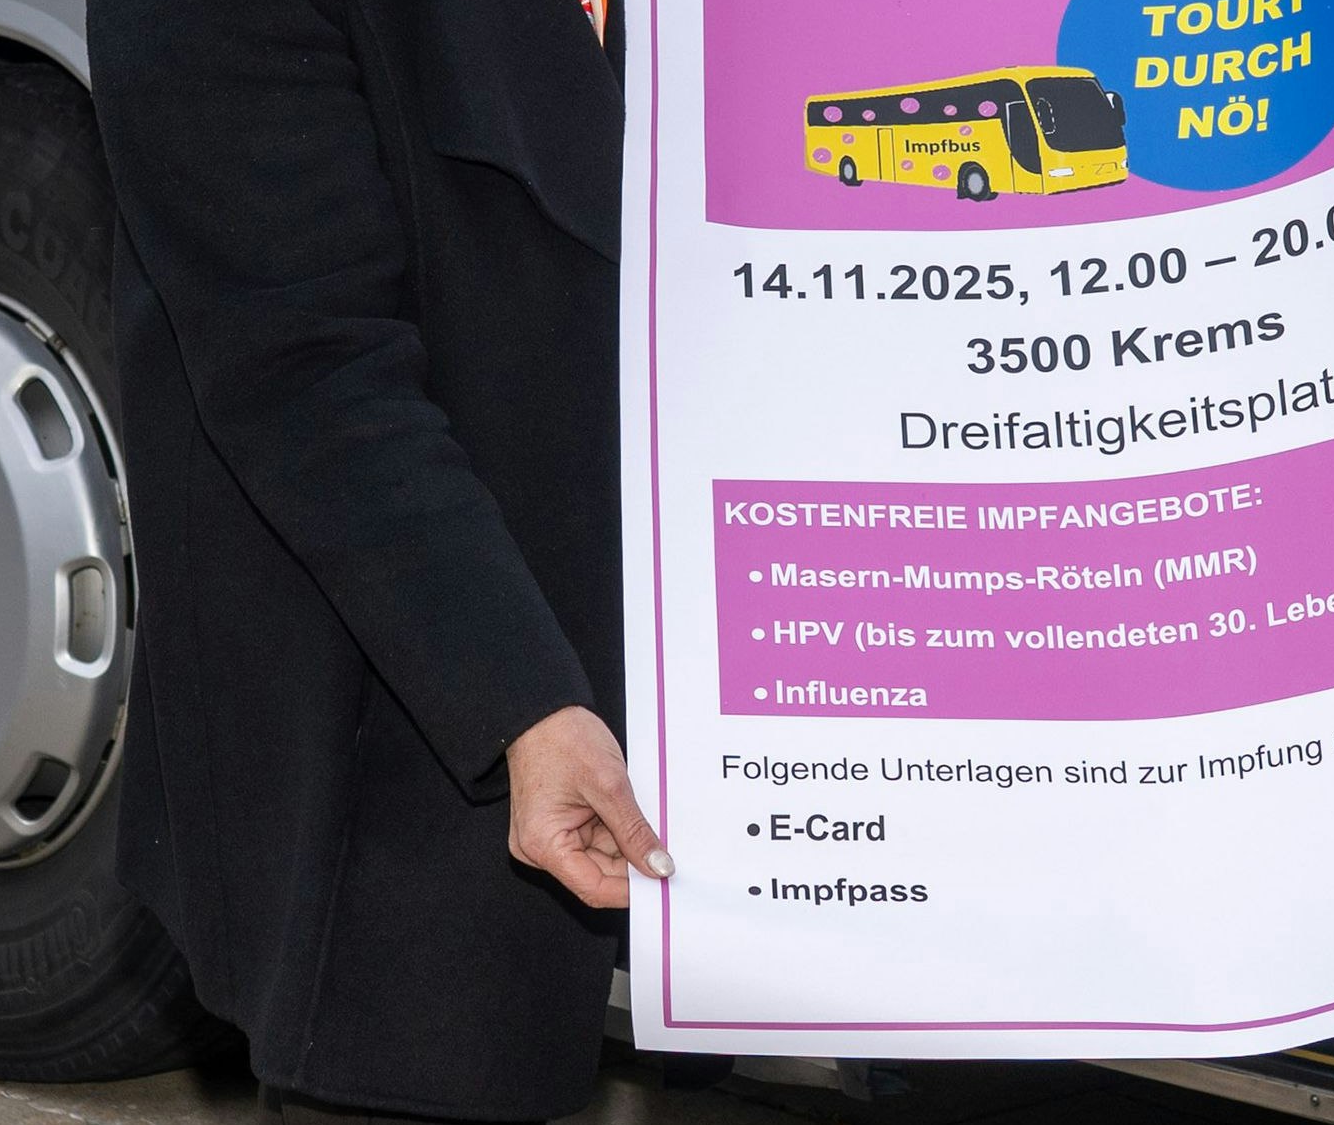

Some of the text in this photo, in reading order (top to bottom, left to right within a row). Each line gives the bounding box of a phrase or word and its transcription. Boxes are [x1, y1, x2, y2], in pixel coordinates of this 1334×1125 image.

[1134, 31, 1312, 88] DURCH
[1177, 95, 1269, 139] NÖ!
[905, 138, 981, 155] Impfbus
[733, 262, 1030, 306] 14.11.2025,
[1049, 246, 1187, 298] 12.00
[966, 311, 1286, 374] 3500 Krems
[724, 483, 1263, 530] KOSTENFREIE IMPFANGEBOTE:
[770, 545, 1258, 595] Masern-Mumps-Röteln (MMR)
[773, 620, 844, 645] HPV
[854, 621, 916, 652] (bis
[926, 627, 995, 649] zum
[1005, 619, 1198, 650] vollendeten
[1209, 608, 1256, 637] 30.
[775, 680, 928, 706] Influenza
[722, 754, 869, 785] Folgende
[881, 757, 1053, 788] Unterlagen
[1064, 760, 1128, 784] sind
[1139, 761, 1187, 783] zur
[1199, 738, 1323, 780] Impfung
[770, 814, 886, 842] E-Card
[771, 878, 930, 906] Impfpass
